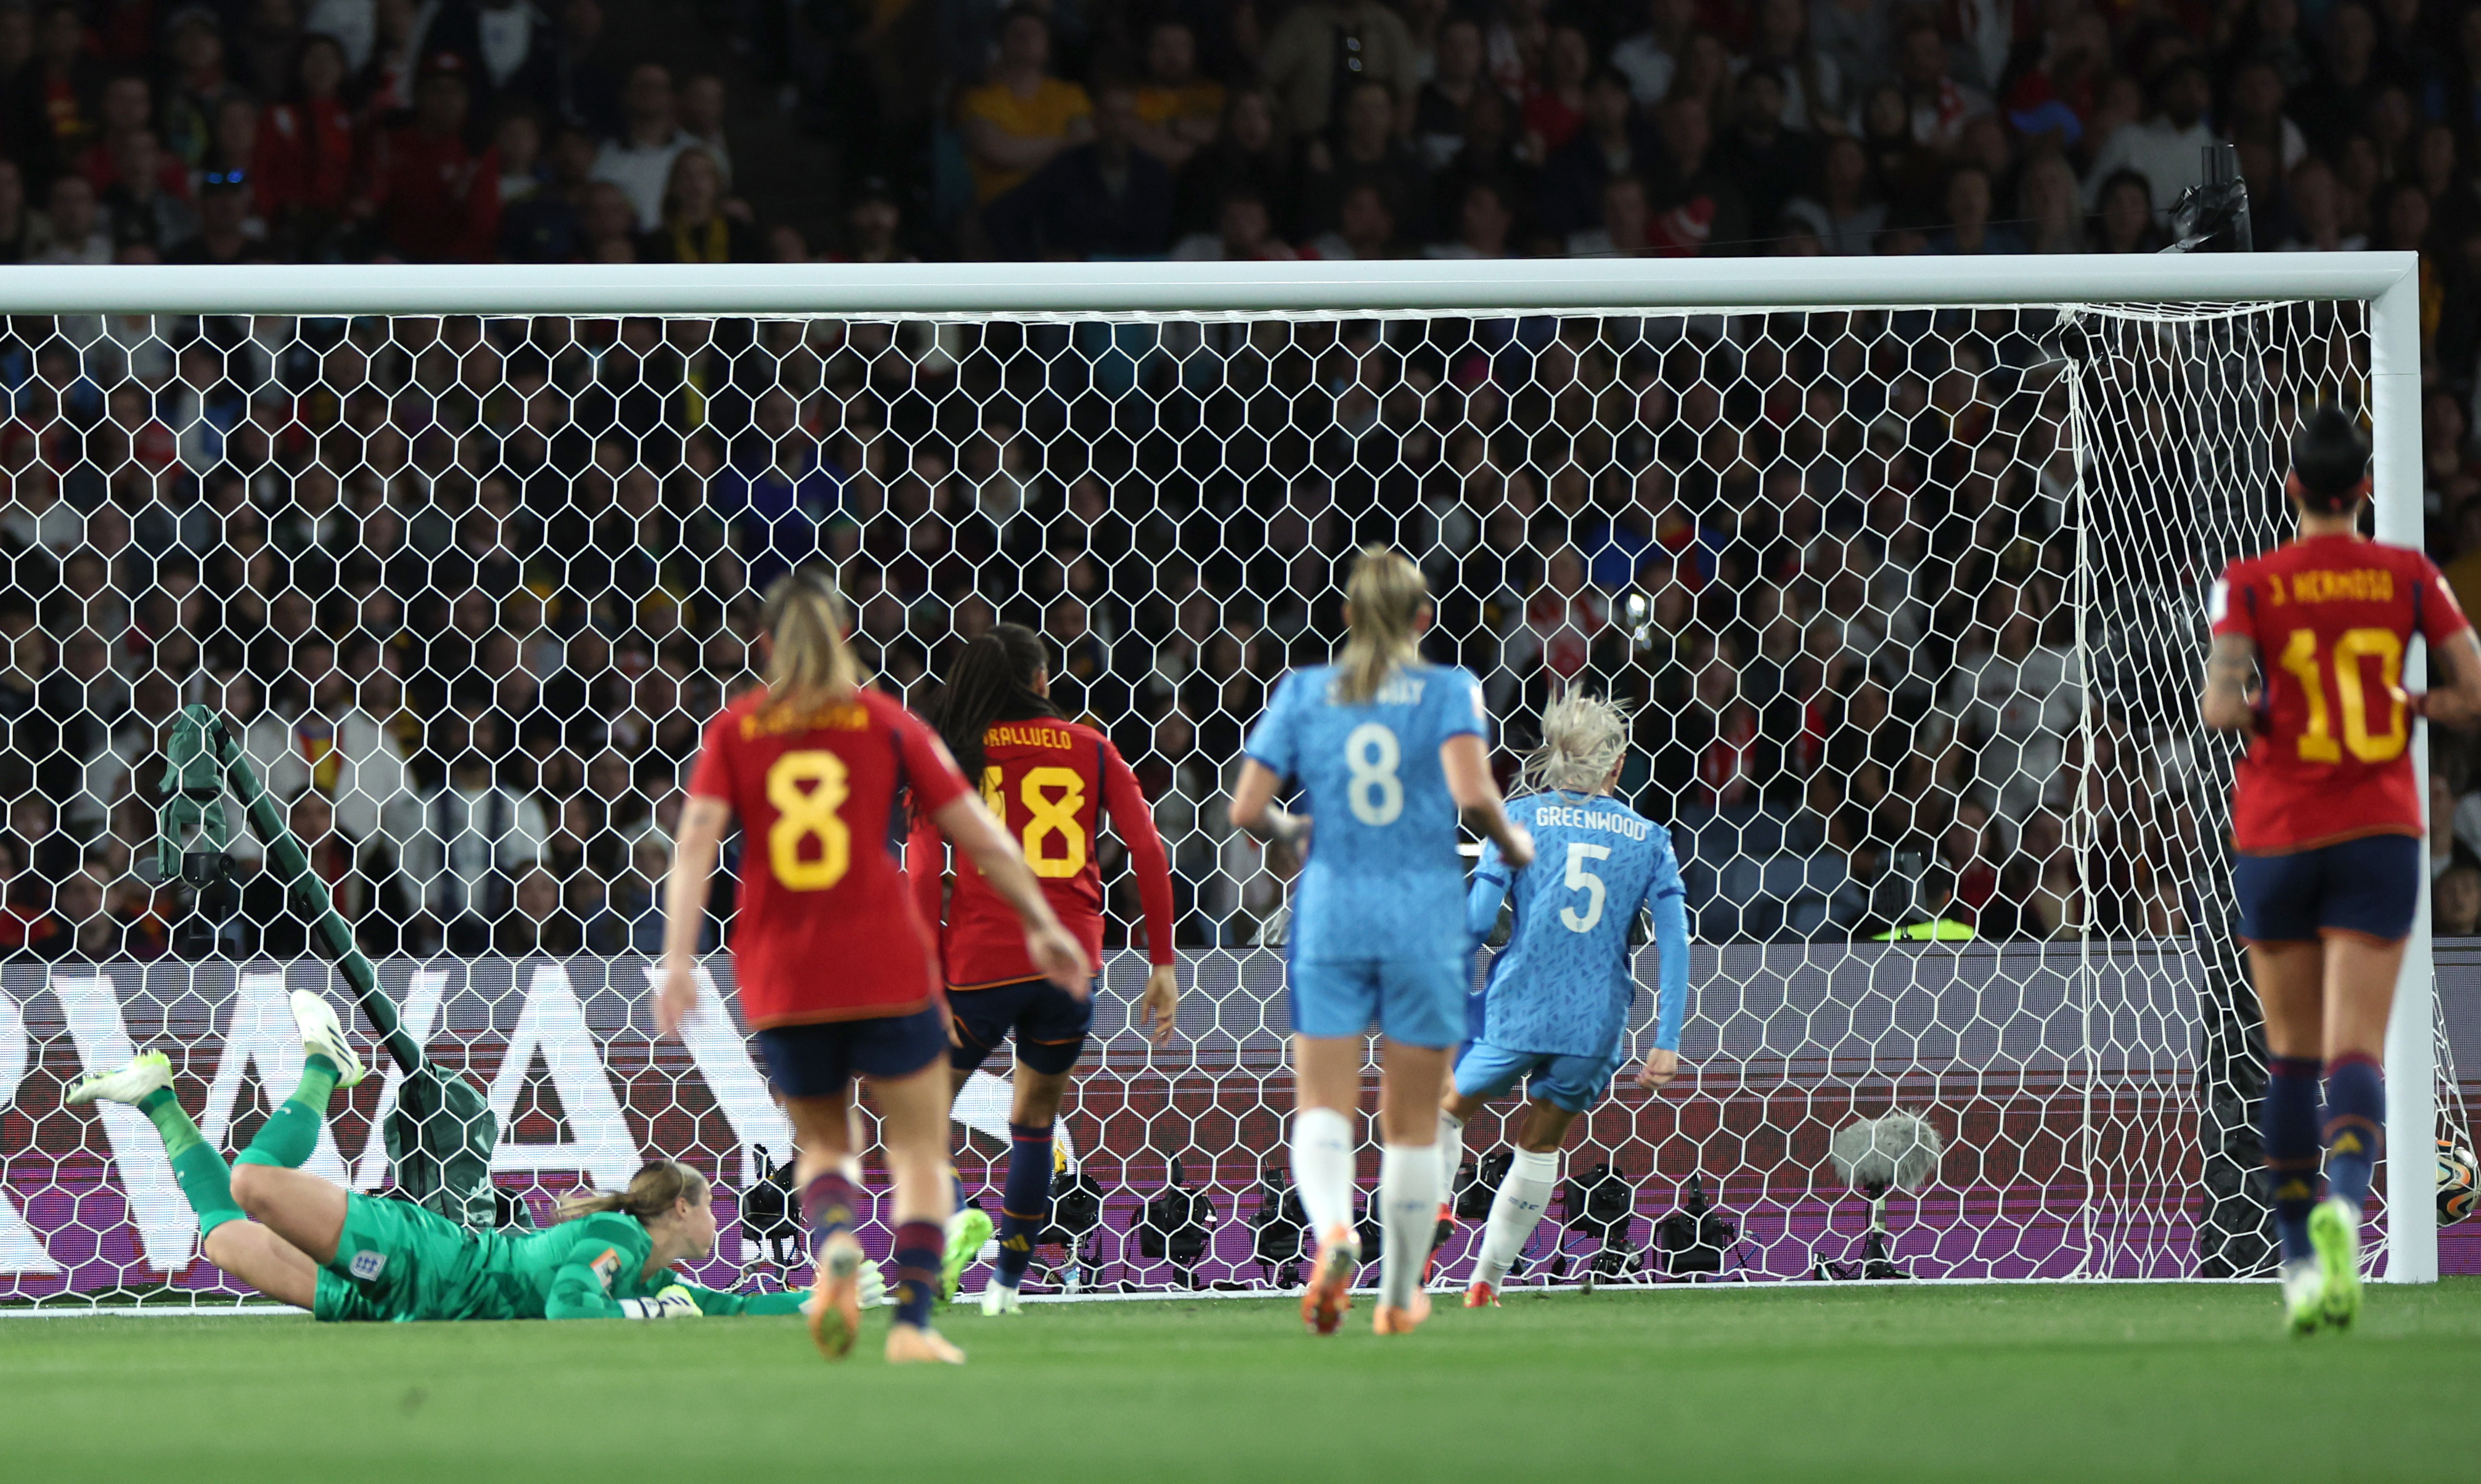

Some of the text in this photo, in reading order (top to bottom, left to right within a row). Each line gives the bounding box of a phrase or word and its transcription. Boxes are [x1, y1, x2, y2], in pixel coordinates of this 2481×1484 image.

[983, 727, 1073, 750] RALLUELO
[2281, 627, 2408, 764] 10
[767, 750, 850, 891] 8
[1345, 723, 1404, 826] 8
[1536, 805, 1646, 841] GREENWOOD
[1560, 842, 1612, 933] 5
